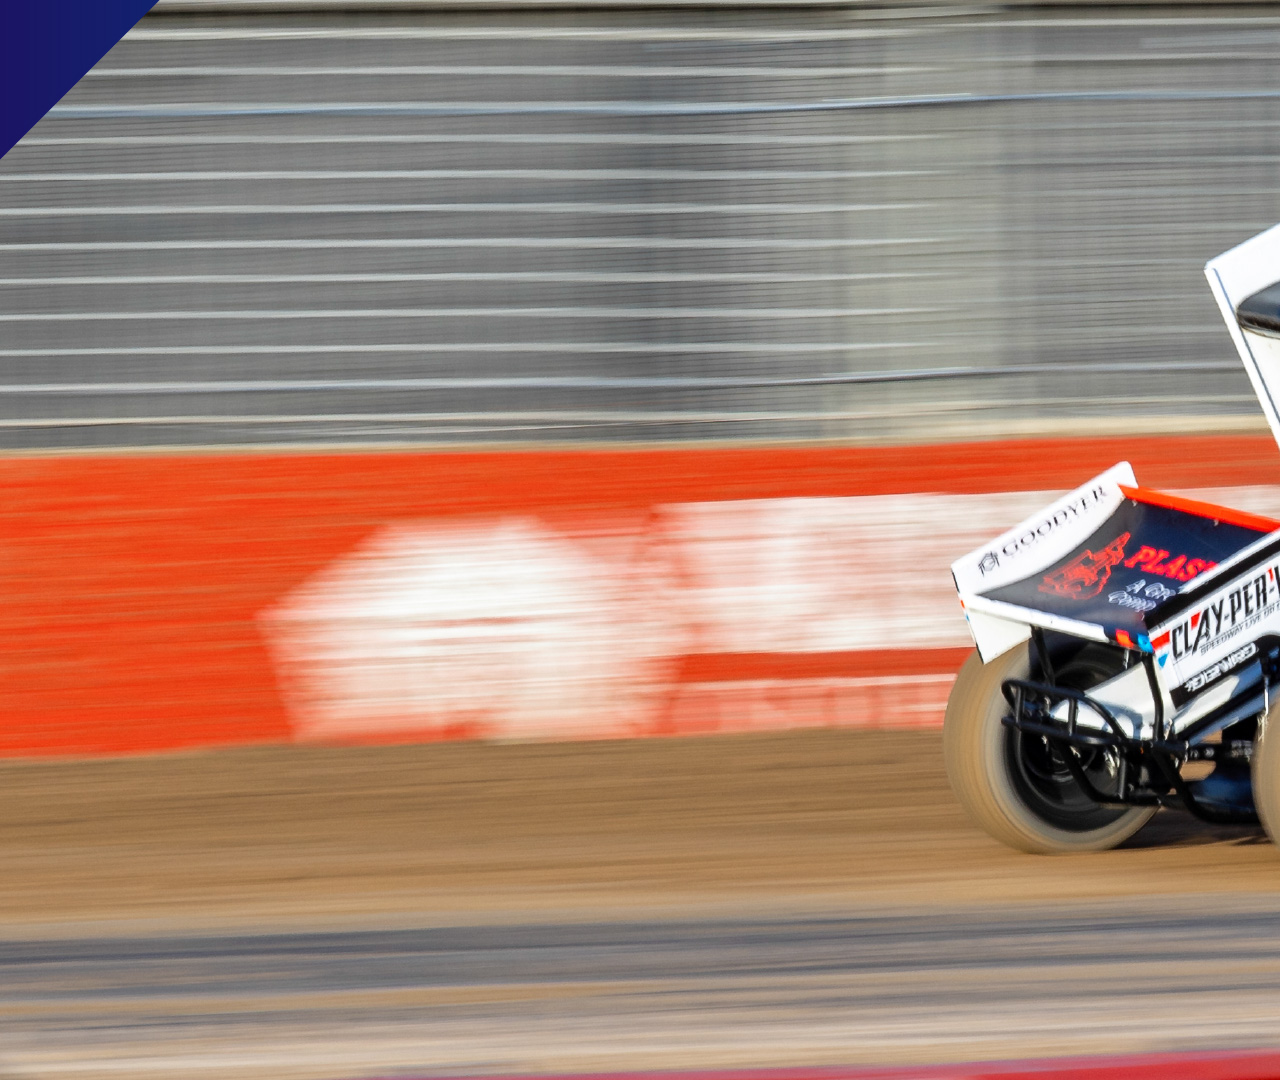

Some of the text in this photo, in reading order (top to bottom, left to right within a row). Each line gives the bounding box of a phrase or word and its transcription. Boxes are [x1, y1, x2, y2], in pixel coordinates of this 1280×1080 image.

[1003, 486, 1106, 557] GOODYER
[1200, 624, 1244, 656] SPEEDWAY
[1245, 615, 1262, 631] LIVE
